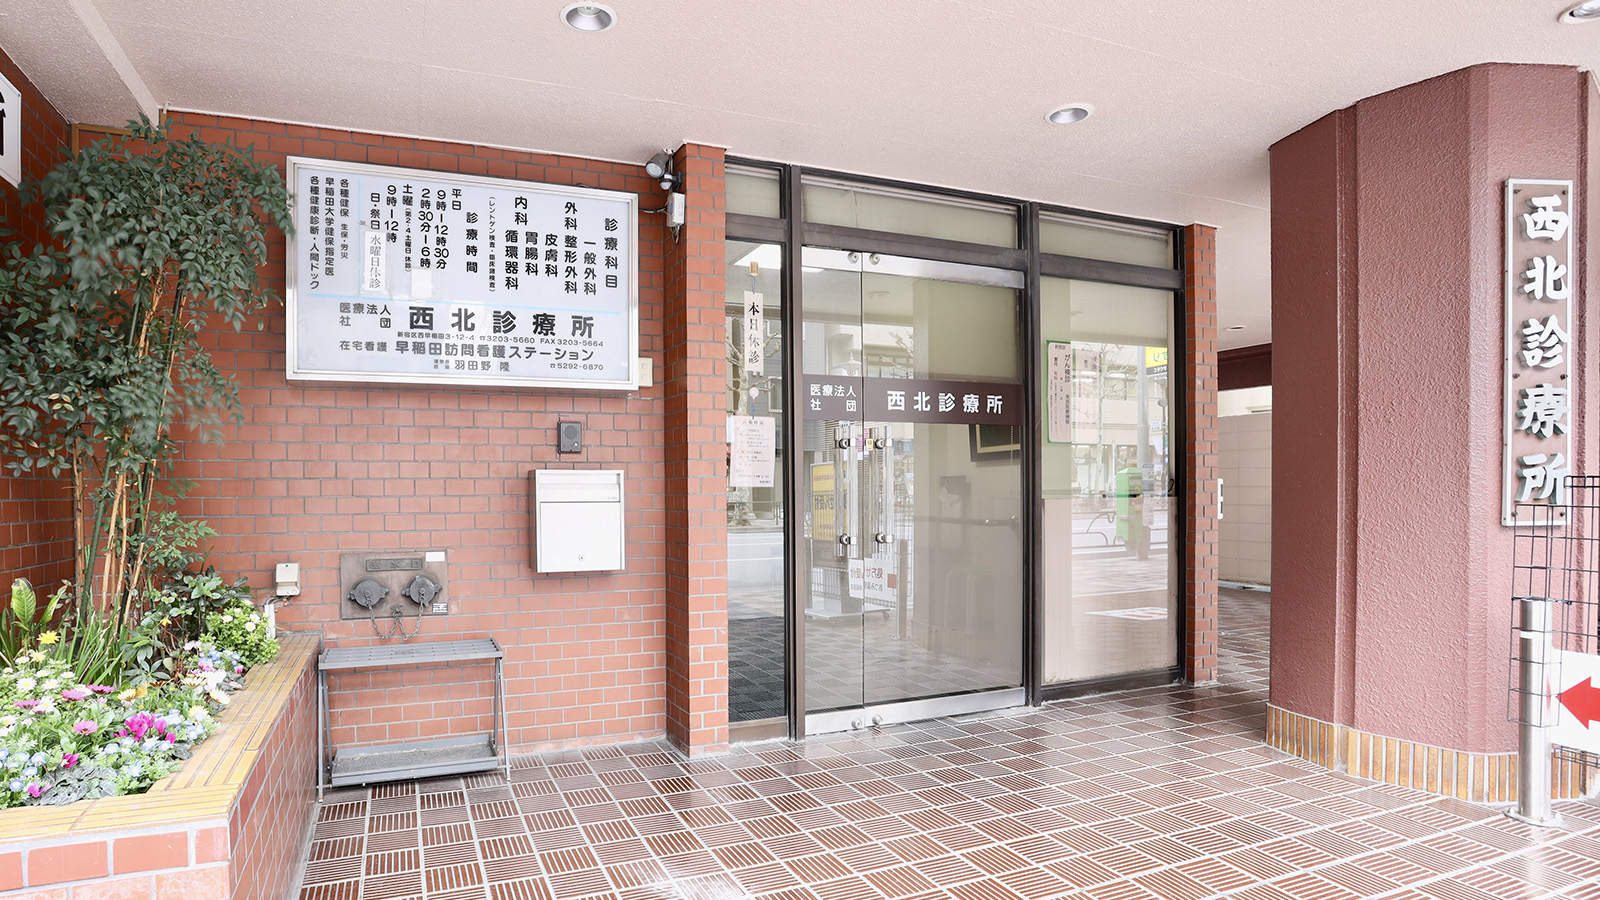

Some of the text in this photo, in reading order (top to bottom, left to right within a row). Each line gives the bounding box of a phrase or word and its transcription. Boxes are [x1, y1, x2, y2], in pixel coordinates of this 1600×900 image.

[340, 179, 349, 218] 各種健保
[370, 192, 381, 230] 日・祭日
[451, 189, 462, 211] 平日
[514, 196, 528, 226] 内科
[309, 176, 320, 290] 各種健康診断・人間ドック
[324, 177, 335, 276] 早稲田大学健保指定医
[465, 212, 478, 273] 診療時間
[564, 201, 578, 294] 外科 整形外科
[369, 235, 382, 289] 水曜日休診
[504, 229, 519, 290] 循環器科
[524, 231, 538, 276] 胃腸科
[544, 233, 558, 278] 皮膚科
[583, 241, 597, 296] 一般外科
[604, 217, 618, 288] 診療科目
[339, 302, 392, 316] 医療法人
[408, 305, 595, 338] 西北診療所
[339, 340, 595, 362] 在宅看護 早稲田訪問看護ステーション
[486, 336, 536, 345] 3203-5660
[747, 301, 760, 364] 本日休診
[1517, 194, 1570, 505] 西北診療所
[454, 359, 492, 371] 羽田野
[499, 361, 511, 372] 隆
[556, 362, 604, 371] 5292-6870
[810, 384, 857, 398] 医療法人
[886, 390, 1004, 414] 西北診療所
